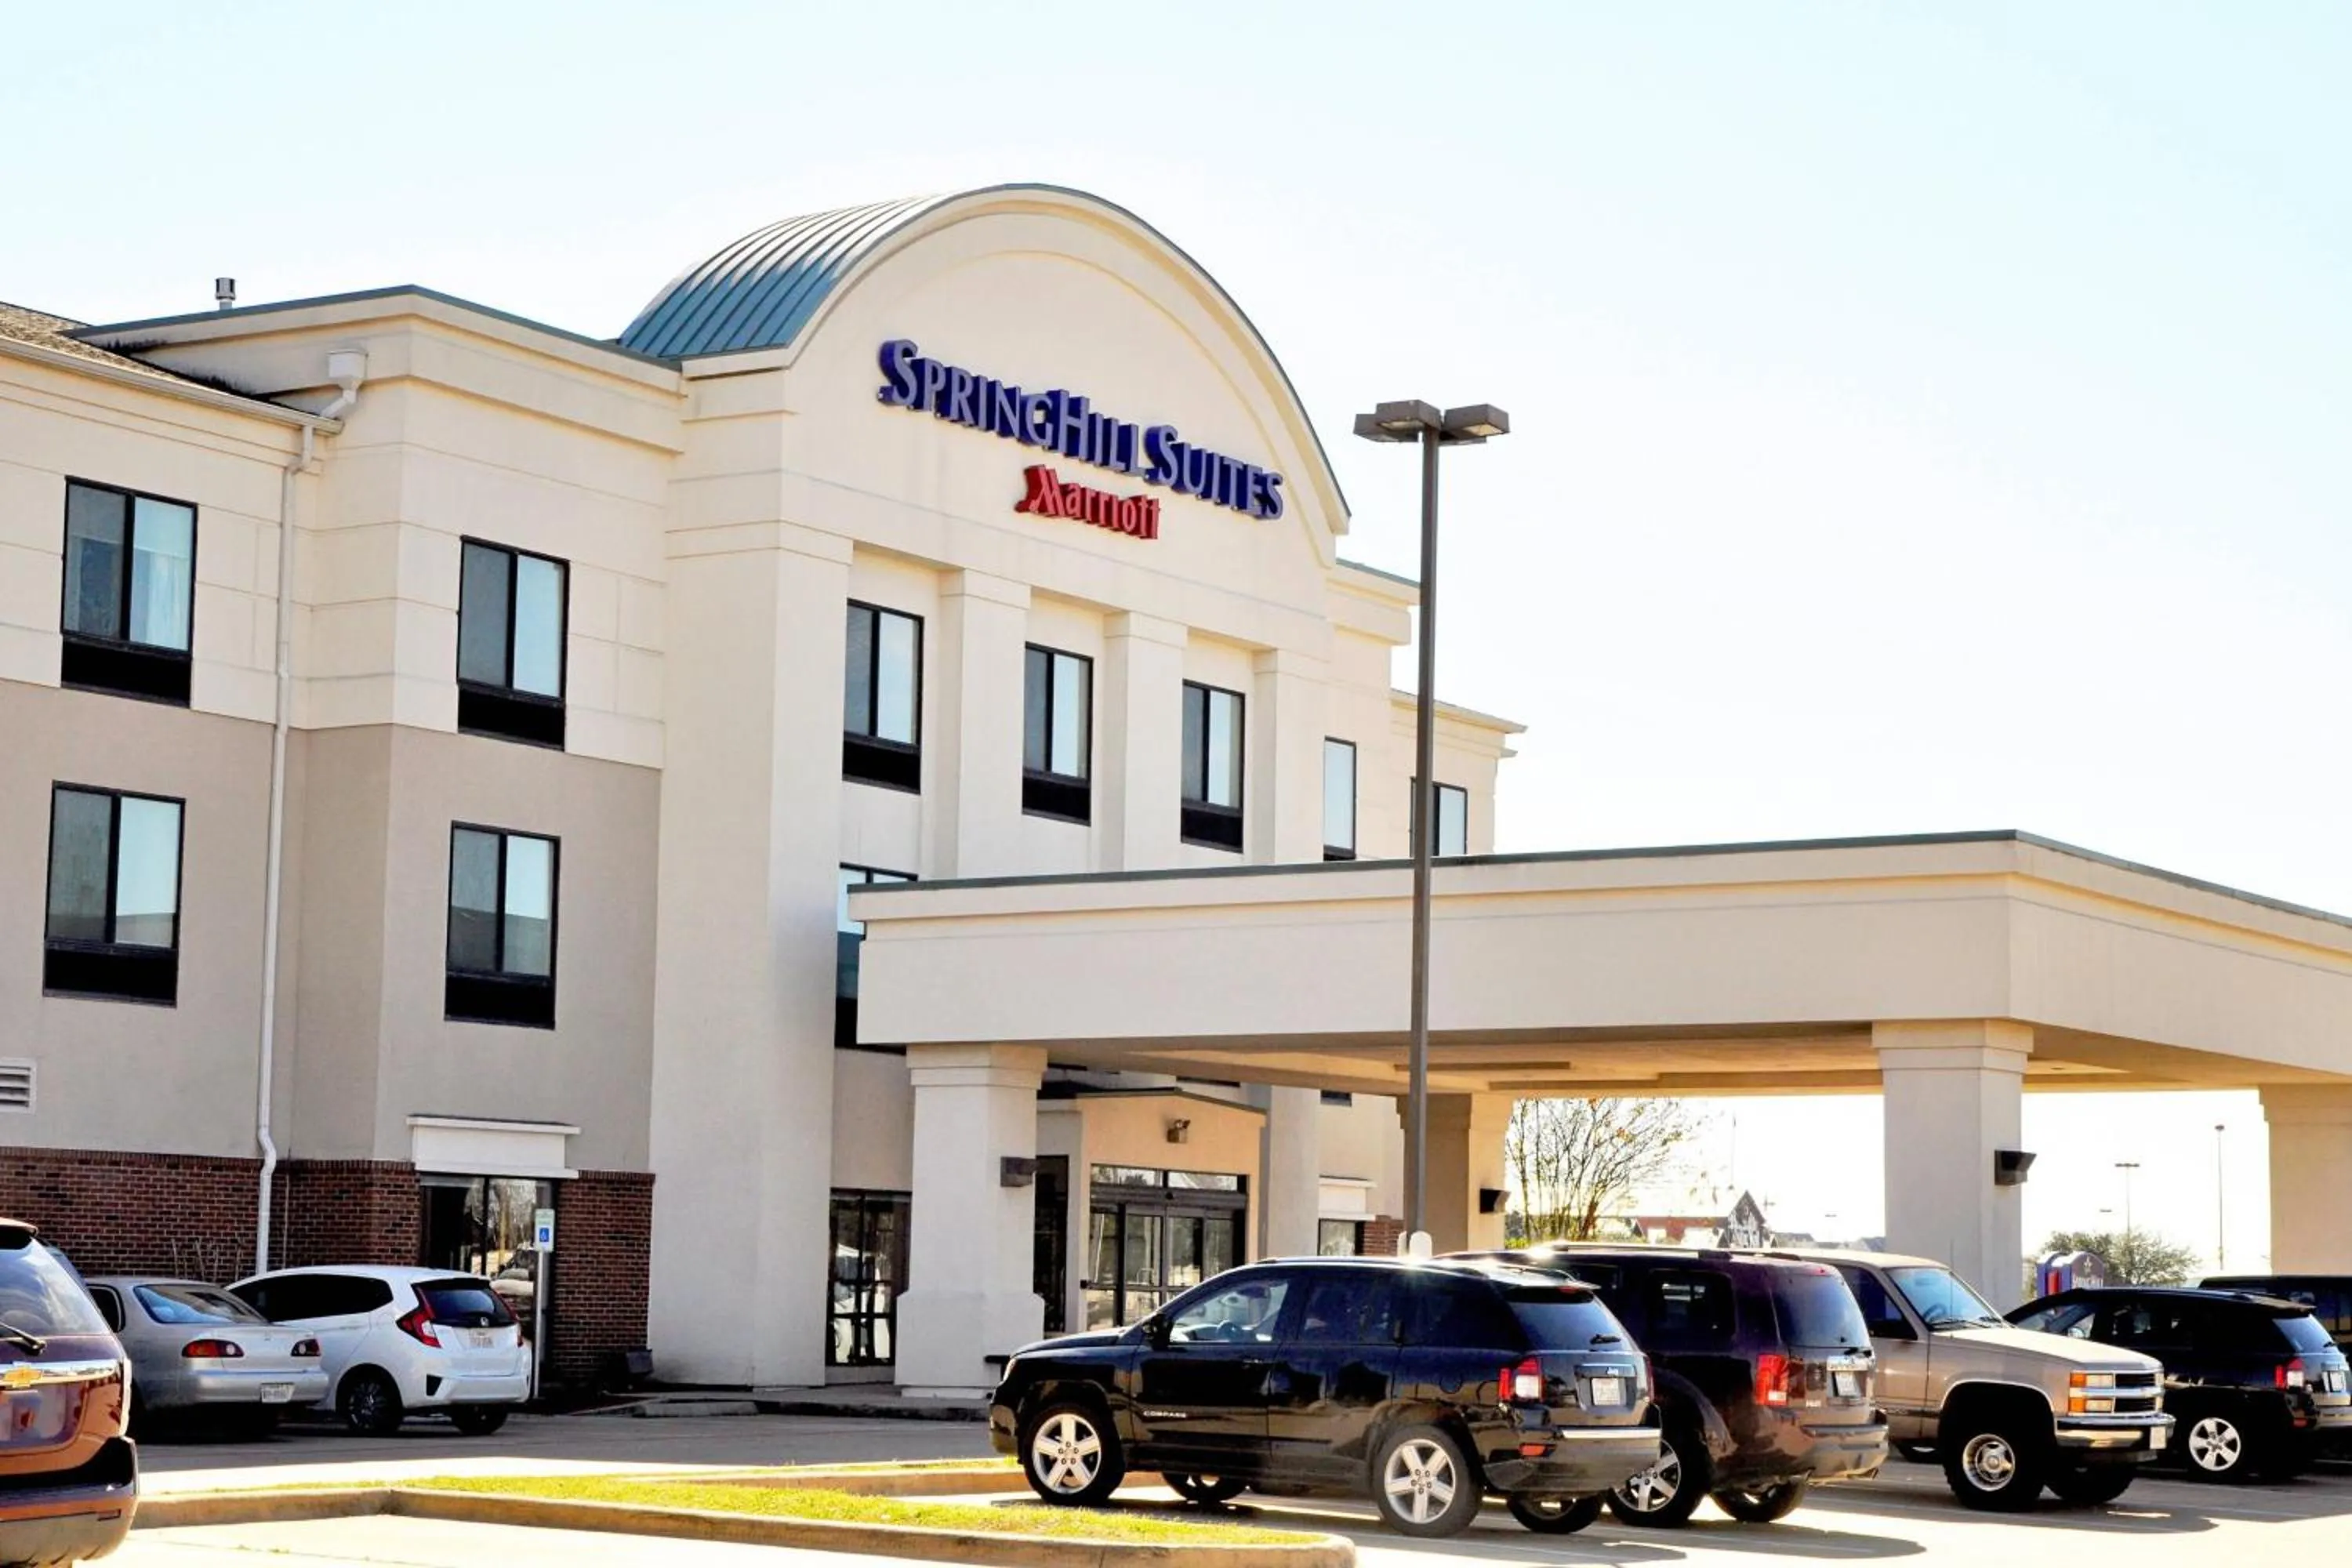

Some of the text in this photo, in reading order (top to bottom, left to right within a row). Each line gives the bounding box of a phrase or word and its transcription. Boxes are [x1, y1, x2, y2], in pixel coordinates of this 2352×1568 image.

[877, 339, 1283, 519] SPRINGHILL SUITES
[1015, 464, 1161, 539] Marriott
